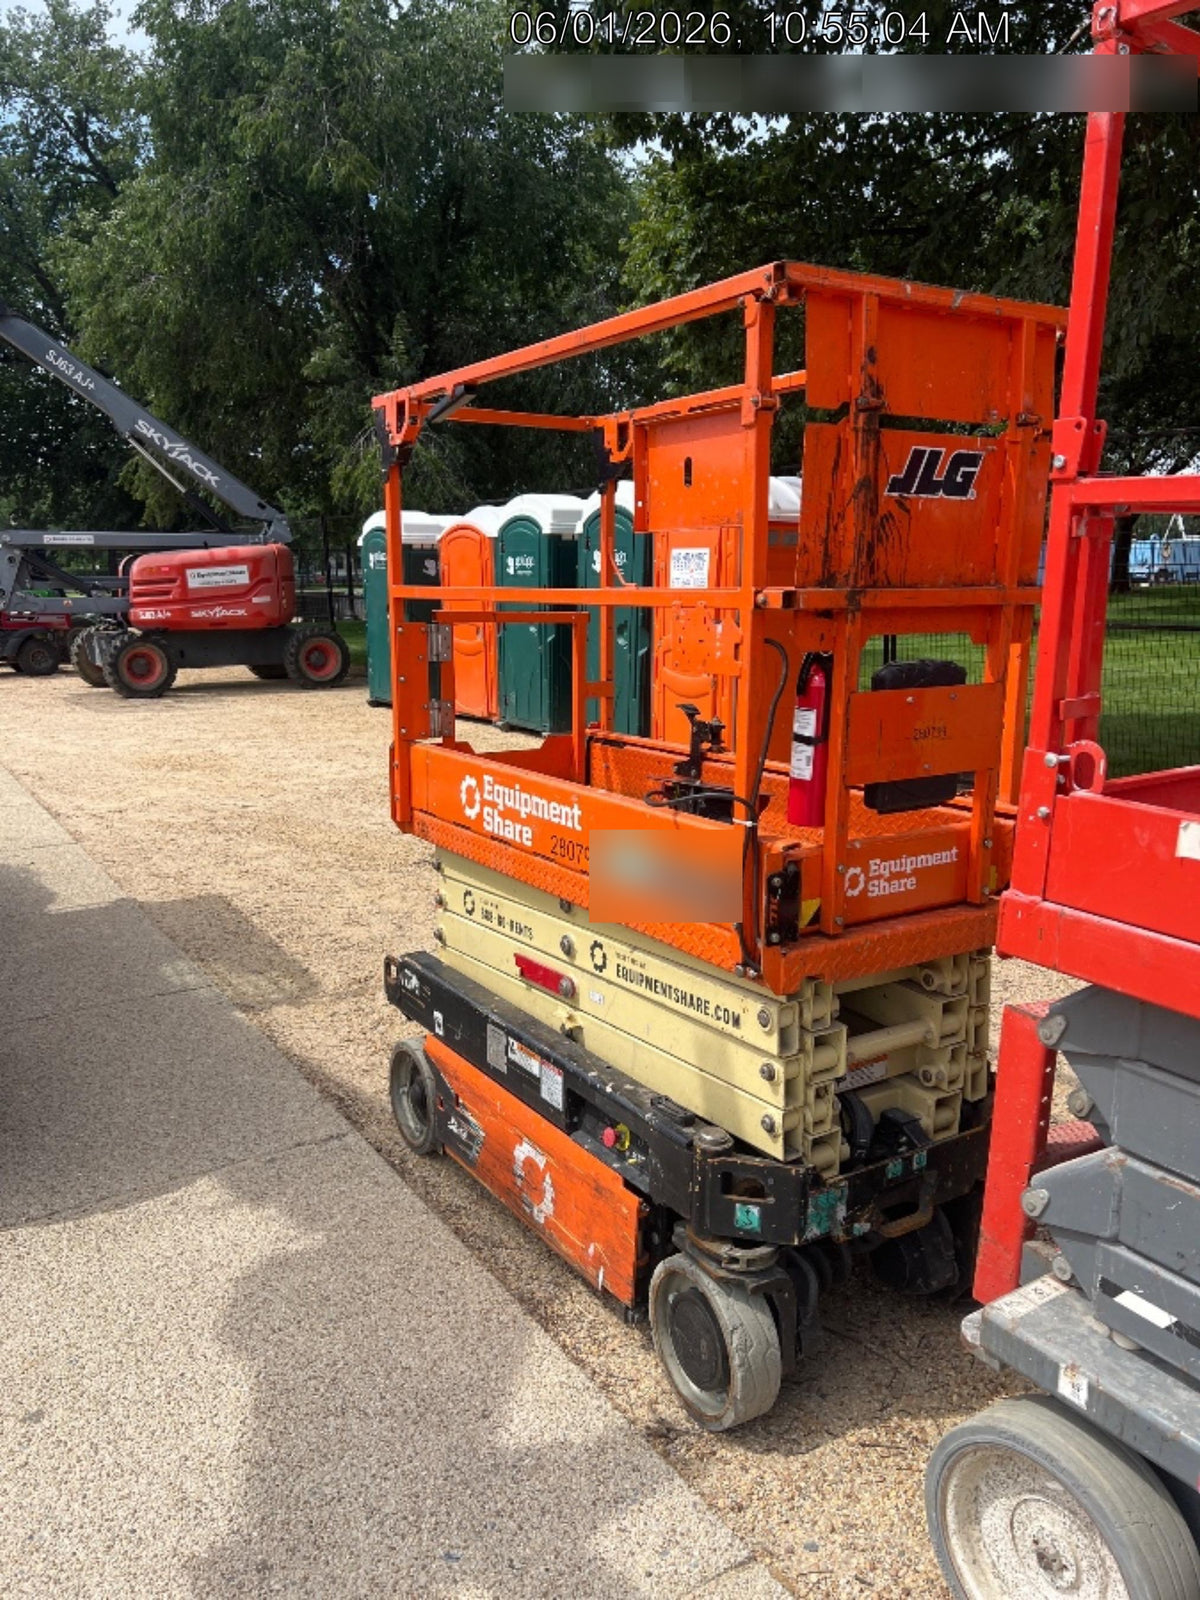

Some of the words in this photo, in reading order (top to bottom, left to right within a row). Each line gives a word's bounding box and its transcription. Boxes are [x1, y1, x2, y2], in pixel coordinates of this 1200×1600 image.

[45, 350, 75, 376] SJ63
[134, 418, 221, 488] SKYJACK
[884, 446, 985, 499] JLG
[190, 606, 248, 618] SKYJACK
[483, 774, 582, 831] Equipment
[483, 806, 533, 847] Share
[868, 846, 959, 878] Equipment
[867, 876, 917, 897] Share
[616, 963, 742, 1028] EQUIPMENTSHARE.COM
